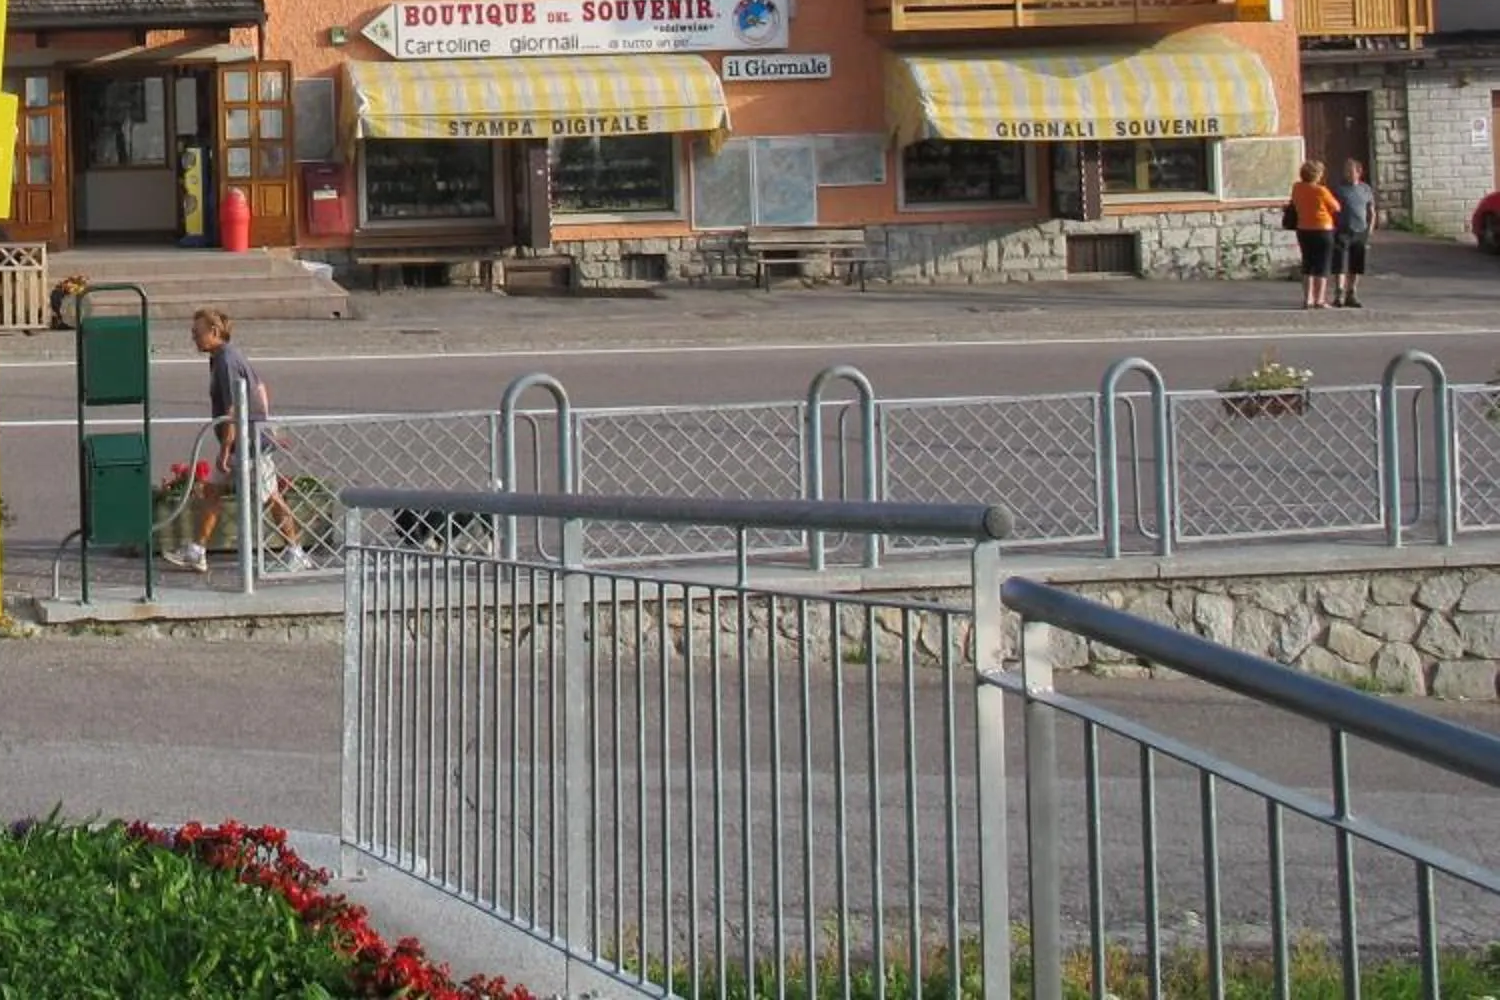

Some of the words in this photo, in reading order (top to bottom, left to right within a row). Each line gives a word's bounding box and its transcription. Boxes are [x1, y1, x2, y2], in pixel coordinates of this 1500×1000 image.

[404, 2, 536, 27] BOUTIQUE
[727, 60, 740, 77] il
[745, 57, 827, 77] Giornale
[448, 118, 534, 137] STAMPA
[551, 114, 650, 135] DIGITALE
[995, 121, 1094, 138] GIORNALI
[1115, 117, 1219, 137] SOUVENIR
